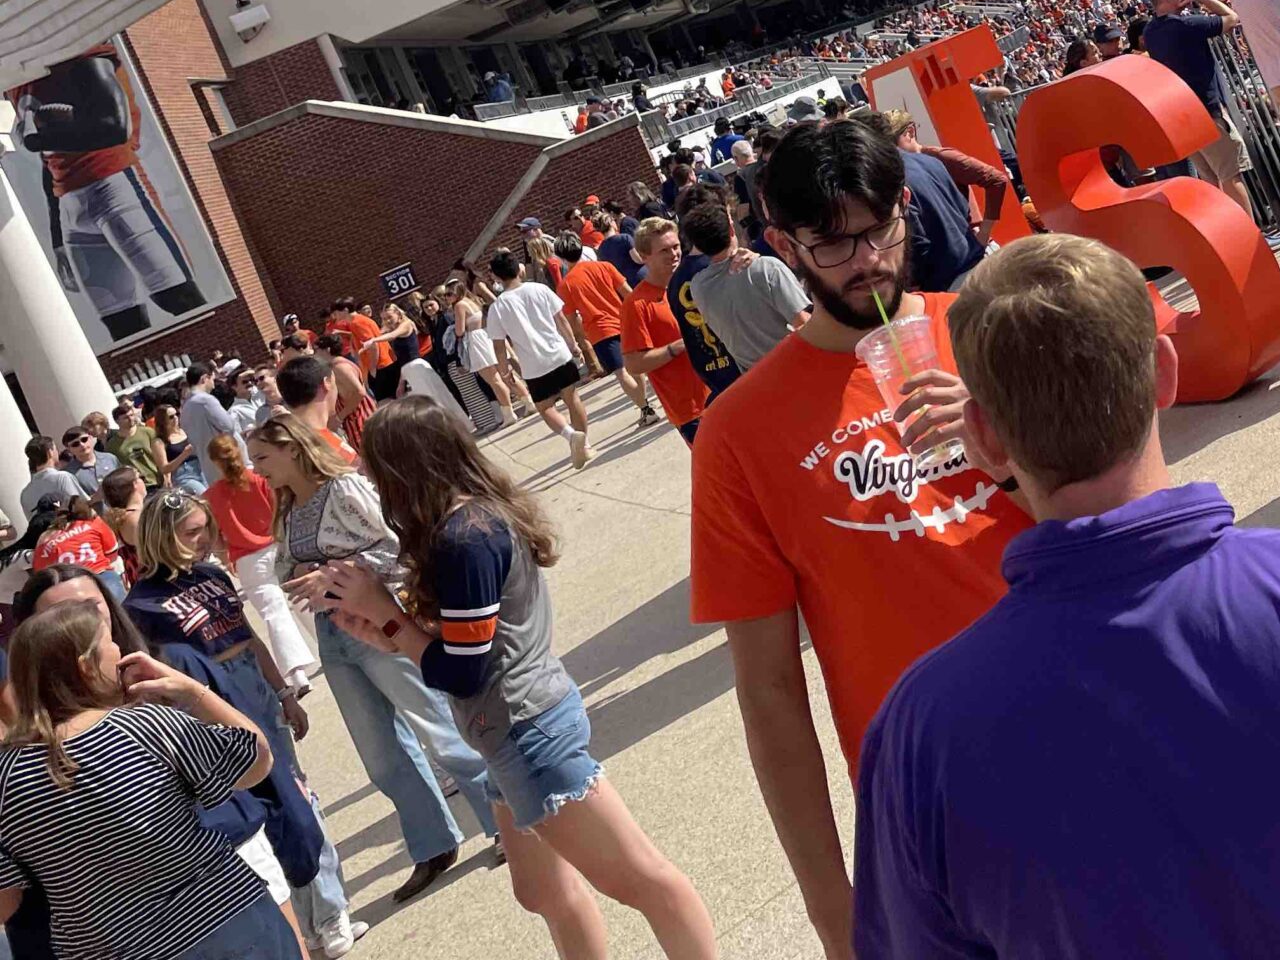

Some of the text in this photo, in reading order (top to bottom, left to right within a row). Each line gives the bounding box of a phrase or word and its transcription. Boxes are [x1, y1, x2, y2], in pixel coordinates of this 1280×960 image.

[388, 272, 416, 294] 301
[800, 408, 893, 472] WE COME
[40, 523, 92, 558] VIRGINIA
